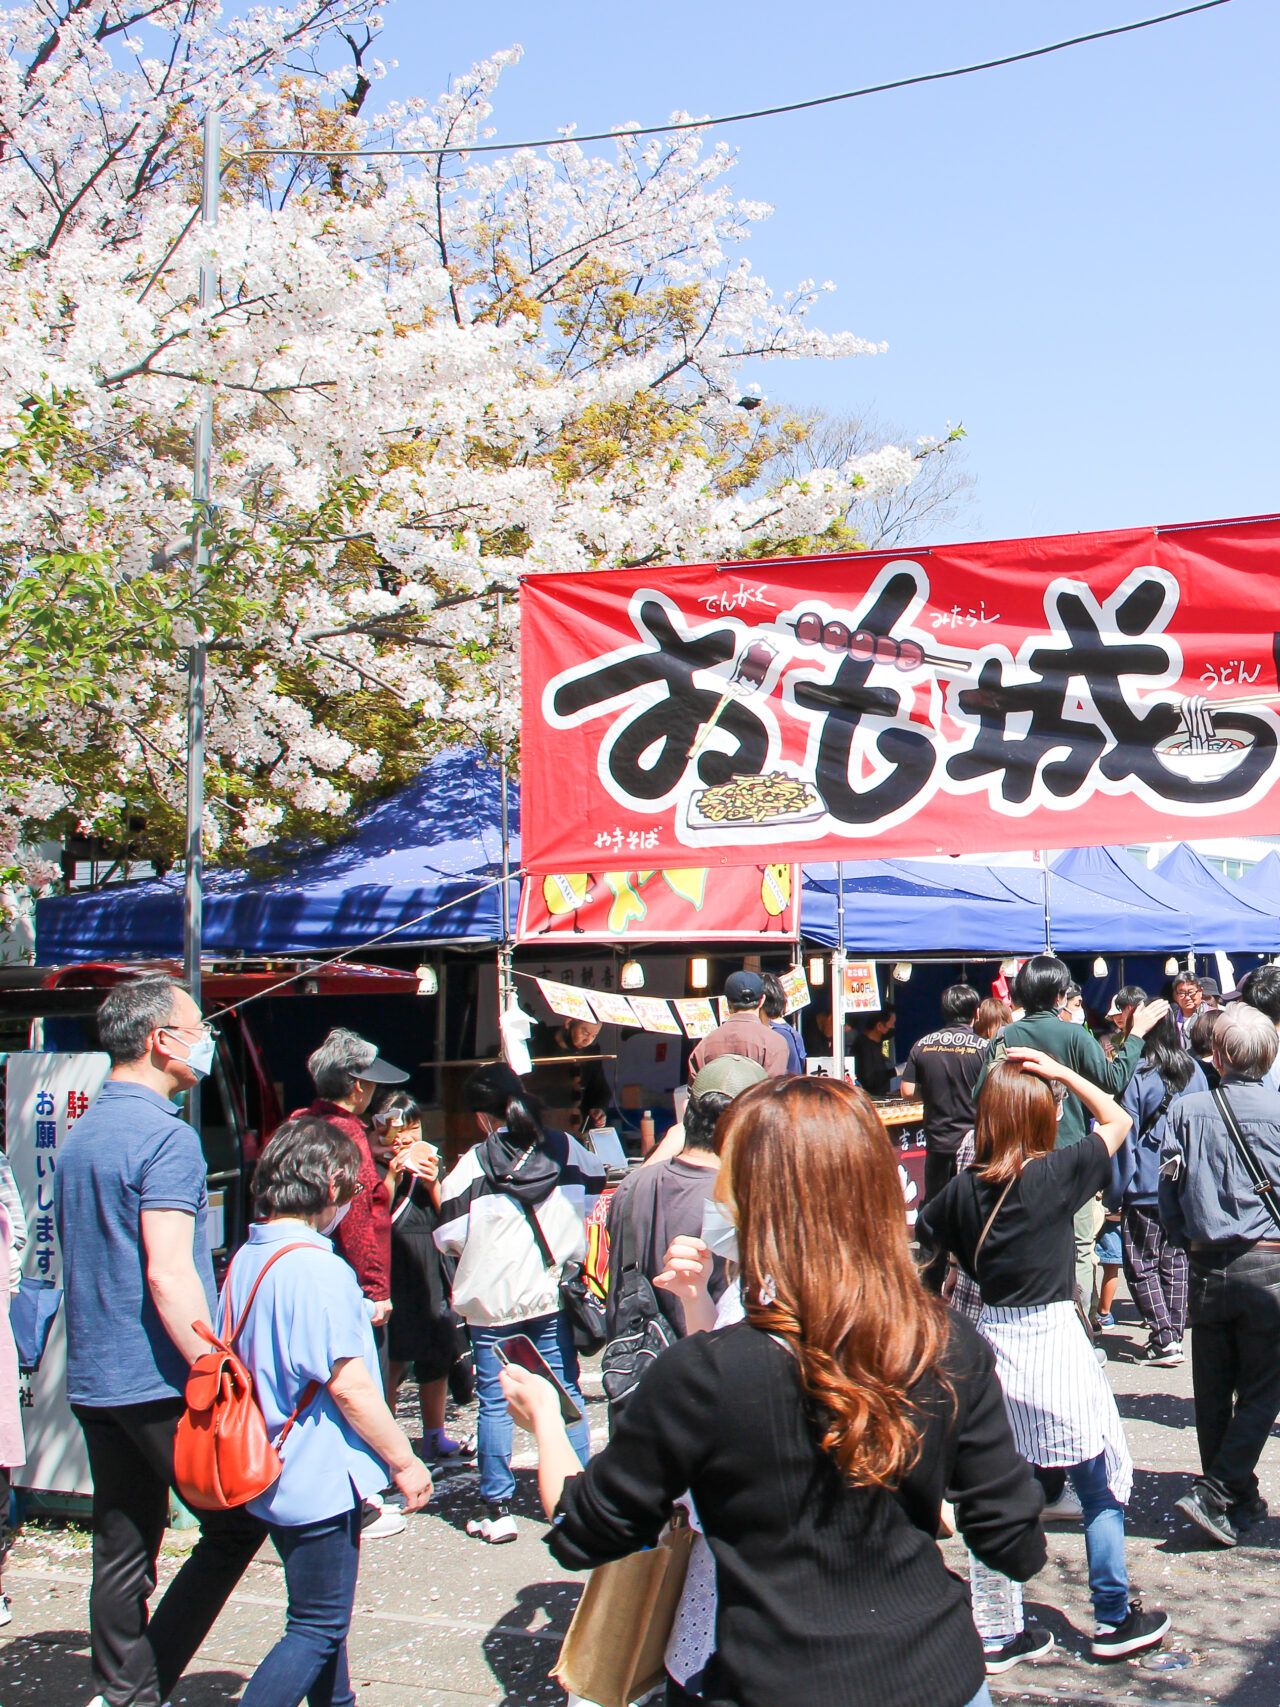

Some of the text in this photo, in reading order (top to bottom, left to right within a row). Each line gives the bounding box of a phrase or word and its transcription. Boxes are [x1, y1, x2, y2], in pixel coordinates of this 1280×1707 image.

[697, 584, 776, 613] でんがく
[929, 601, 1000, 628] みたらし
[1199, 660, 1262, 692] うどん
[593, 825, 663, 854] やきそば
